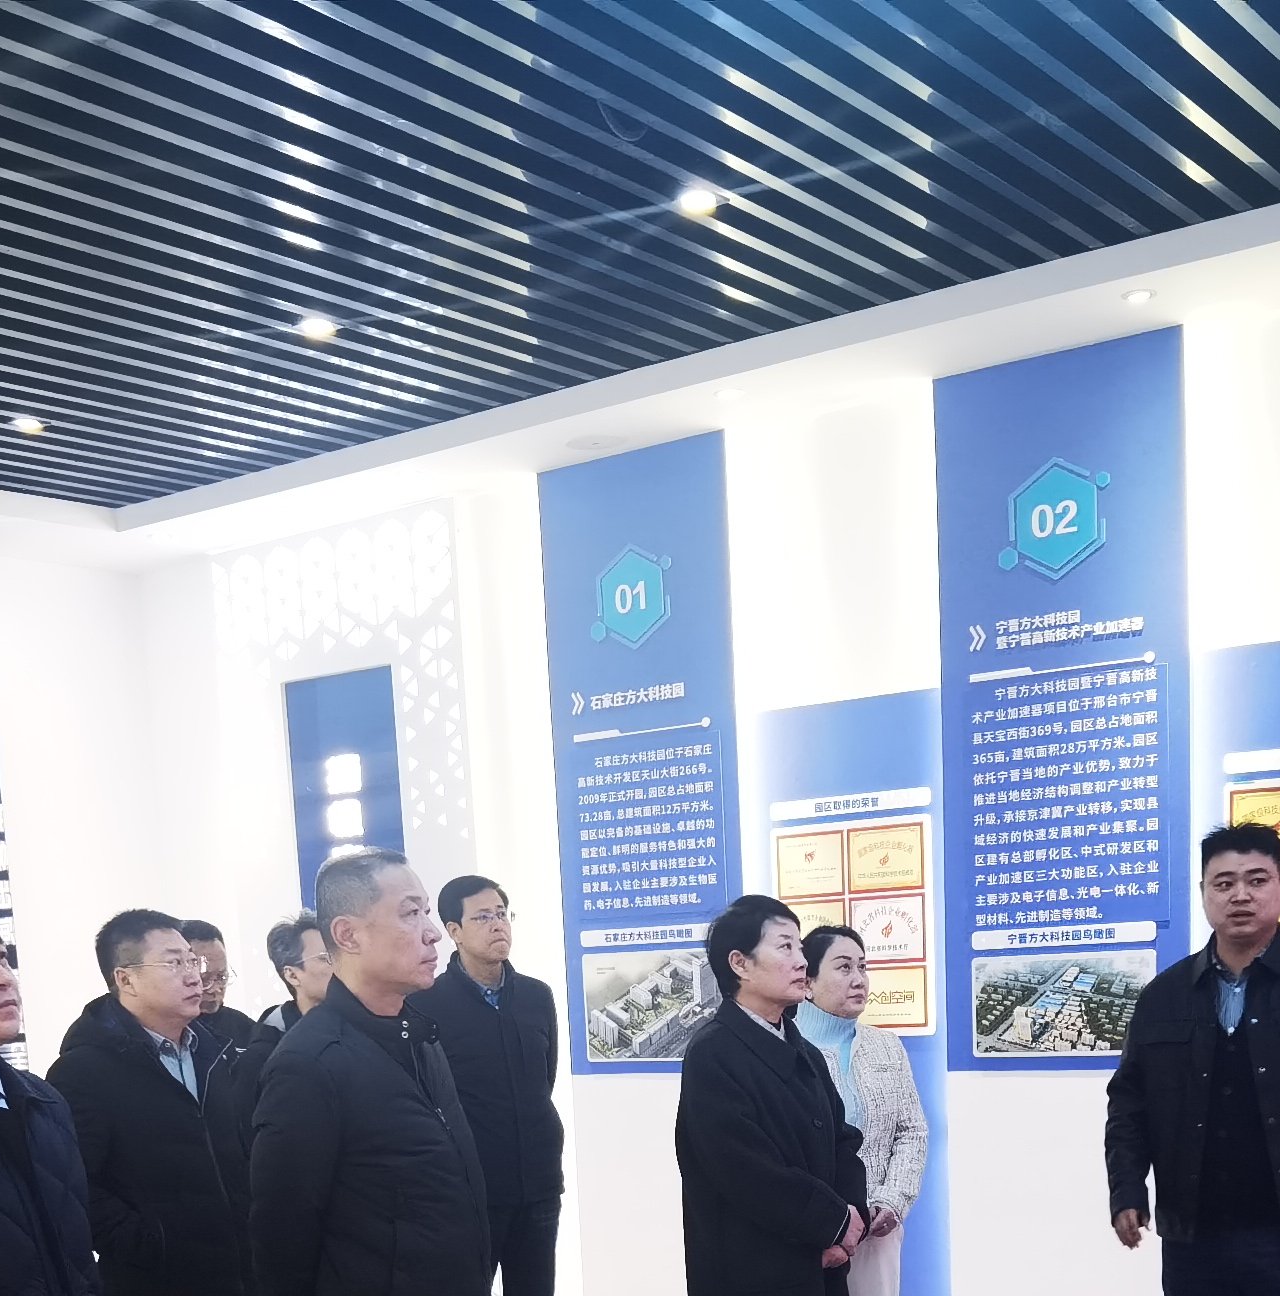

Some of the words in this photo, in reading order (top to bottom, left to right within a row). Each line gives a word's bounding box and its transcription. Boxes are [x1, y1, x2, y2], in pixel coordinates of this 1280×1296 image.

[1031, 500, 1078, 538] 02
[615, 580, 646, 614] 01
[996, 610, 1081, 634] 宁晋方大科技园
[996, 617, 1144, 650] 暨宁晋高新技术产业加速器
[590, 682, 685, 711] 石家庄方大科技园
[995, 666, 1157, 701] 宁晋方大科技园暨宁晋高新技
[972, 689, 1158, 725] 术产业加速器项目位于邢台市宁晋
[594, 744, 712, 768] 石家庄方大科技园位于石家庄
[973, 775, 1158, 806] 推进当地经济结构调整和产业转型
[815, 797, 879, 814] 园区取得的荣誉
[974, 818, 1159, 846] 域经济的快速发展和产业集聚。园
[975, 881, 1160, 907] 主要涉及电子信息、光电一体化、新
[976, 906, 1103, 926] 型材料、先进制造等领域。
[1008, 928, 1116, 945] 宁晋方大科技园鸟瞰图
